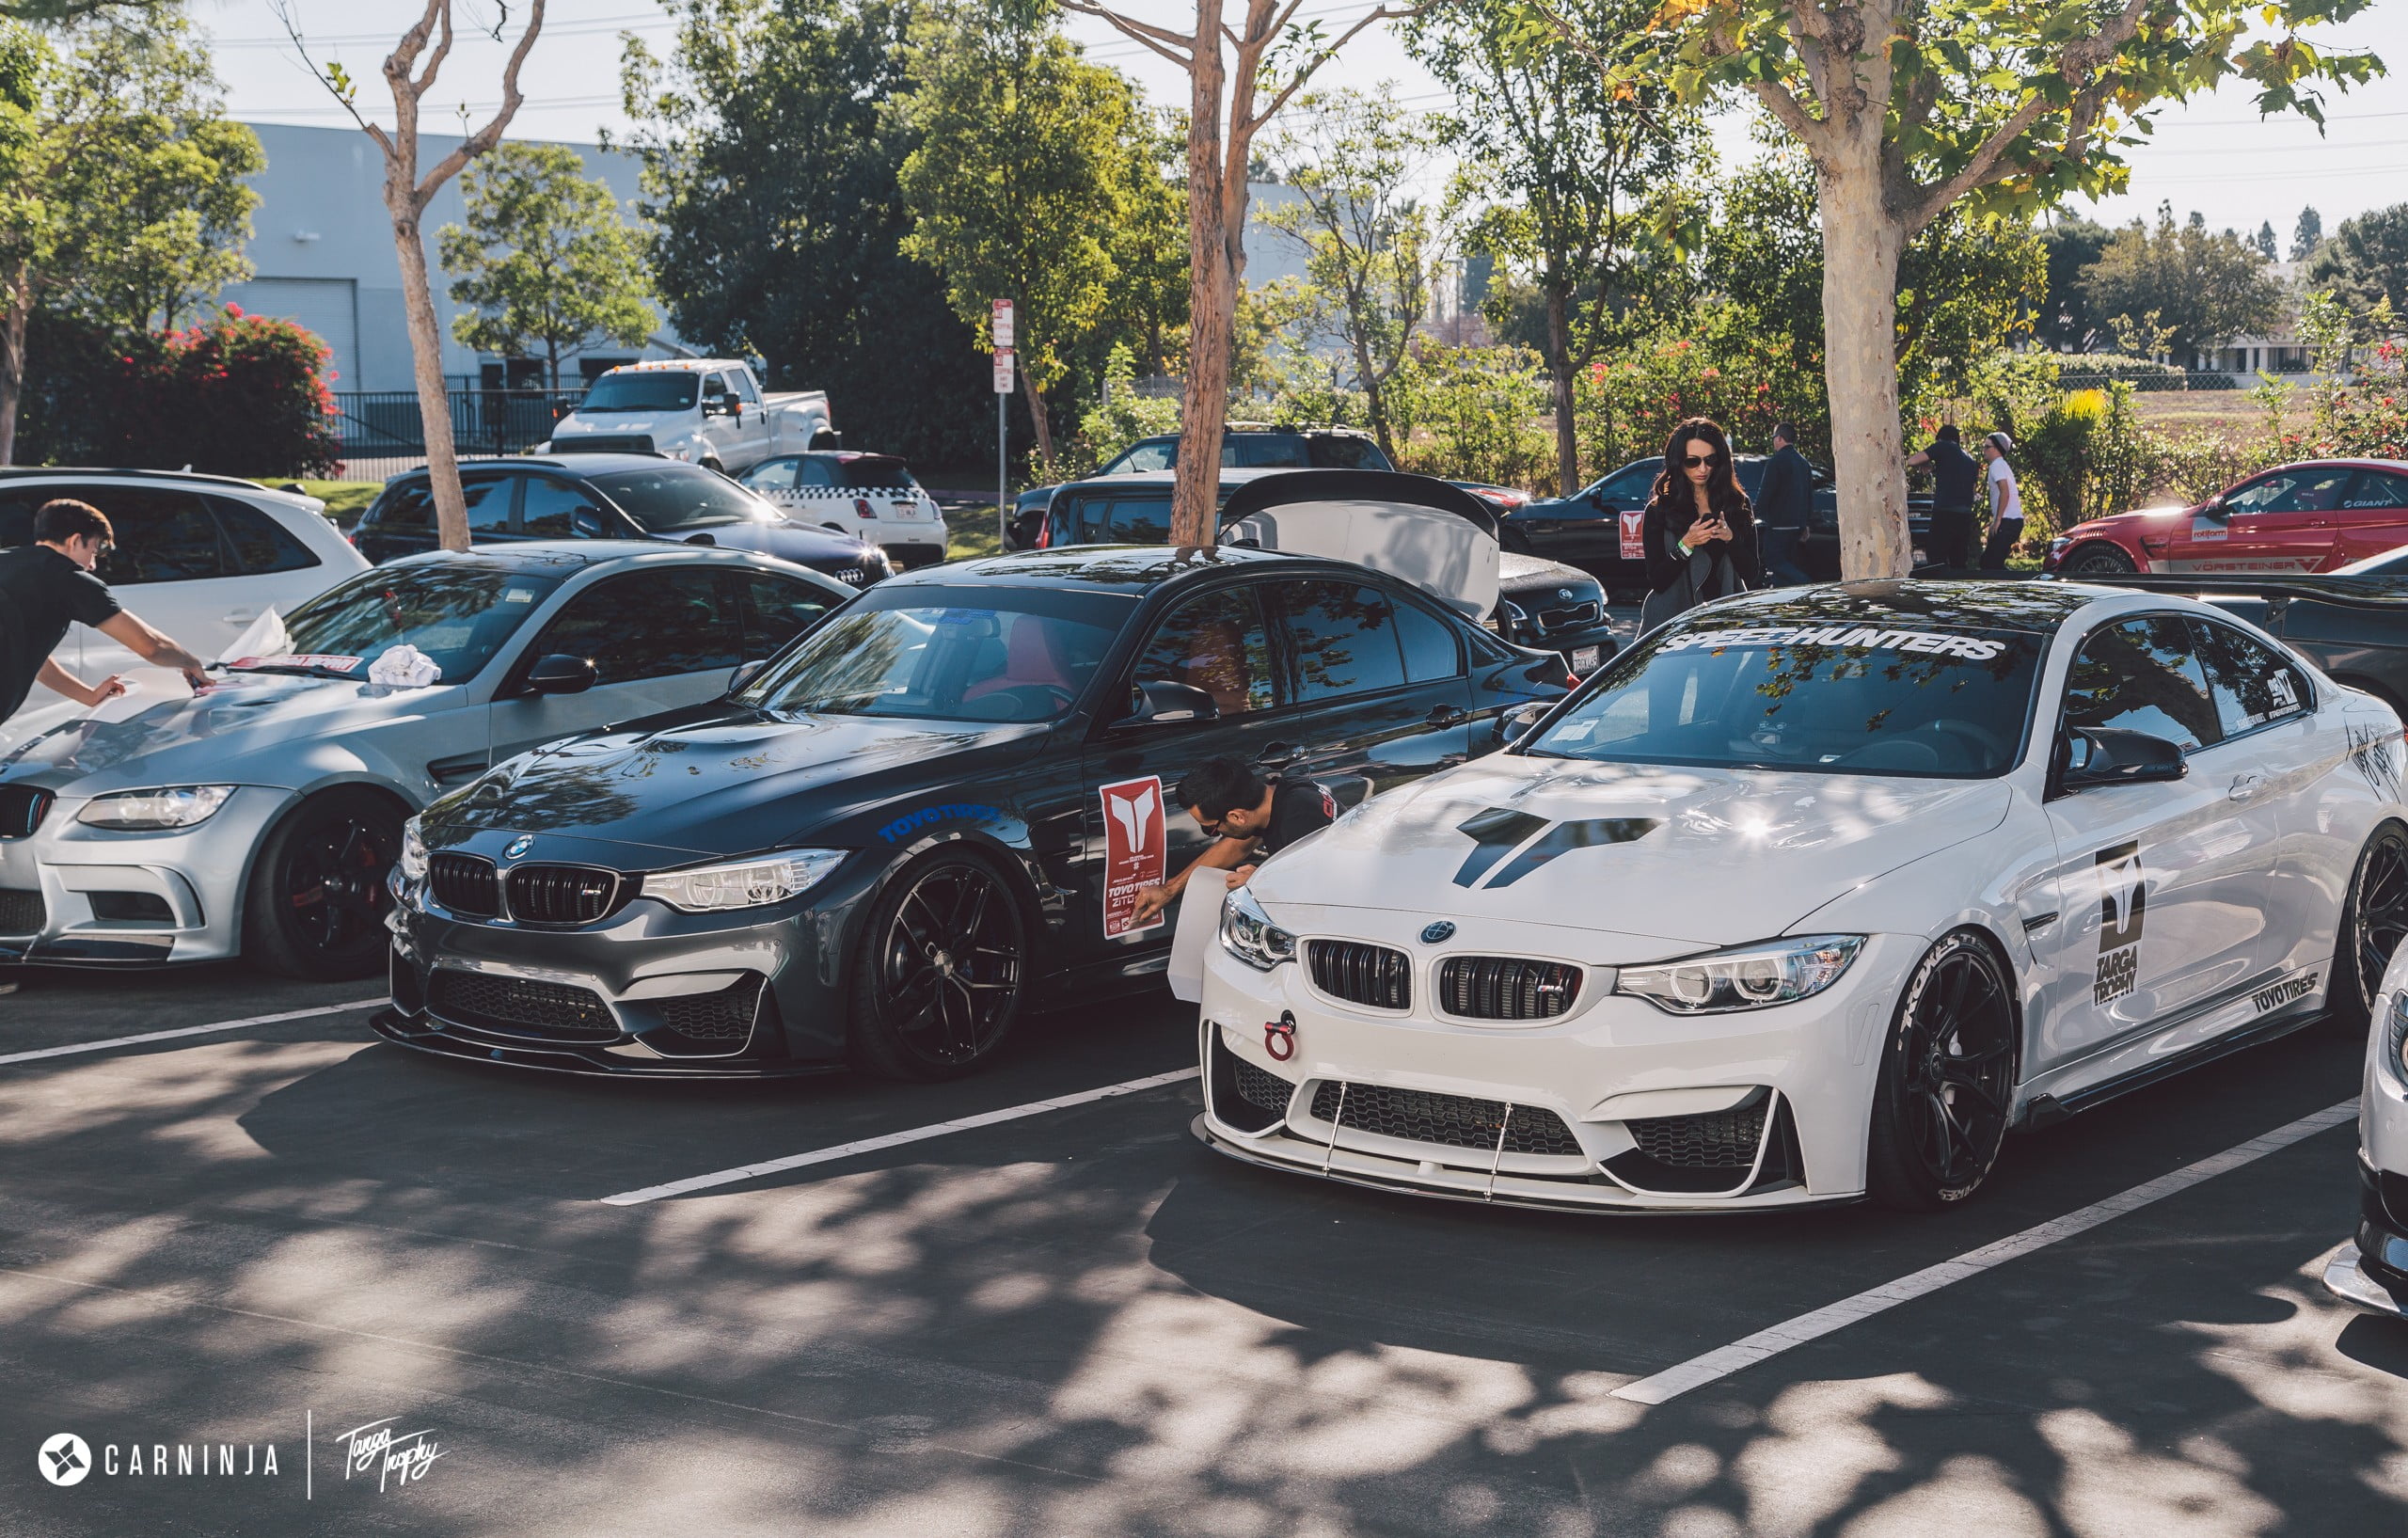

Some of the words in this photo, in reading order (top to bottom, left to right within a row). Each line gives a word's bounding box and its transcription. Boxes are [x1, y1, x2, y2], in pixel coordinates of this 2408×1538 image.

[2194, 530, 2227, 539] rotiform
[2096, 945, 2137, 983] TARGA
[2093, 969, 2137, 1006] TROPHY
